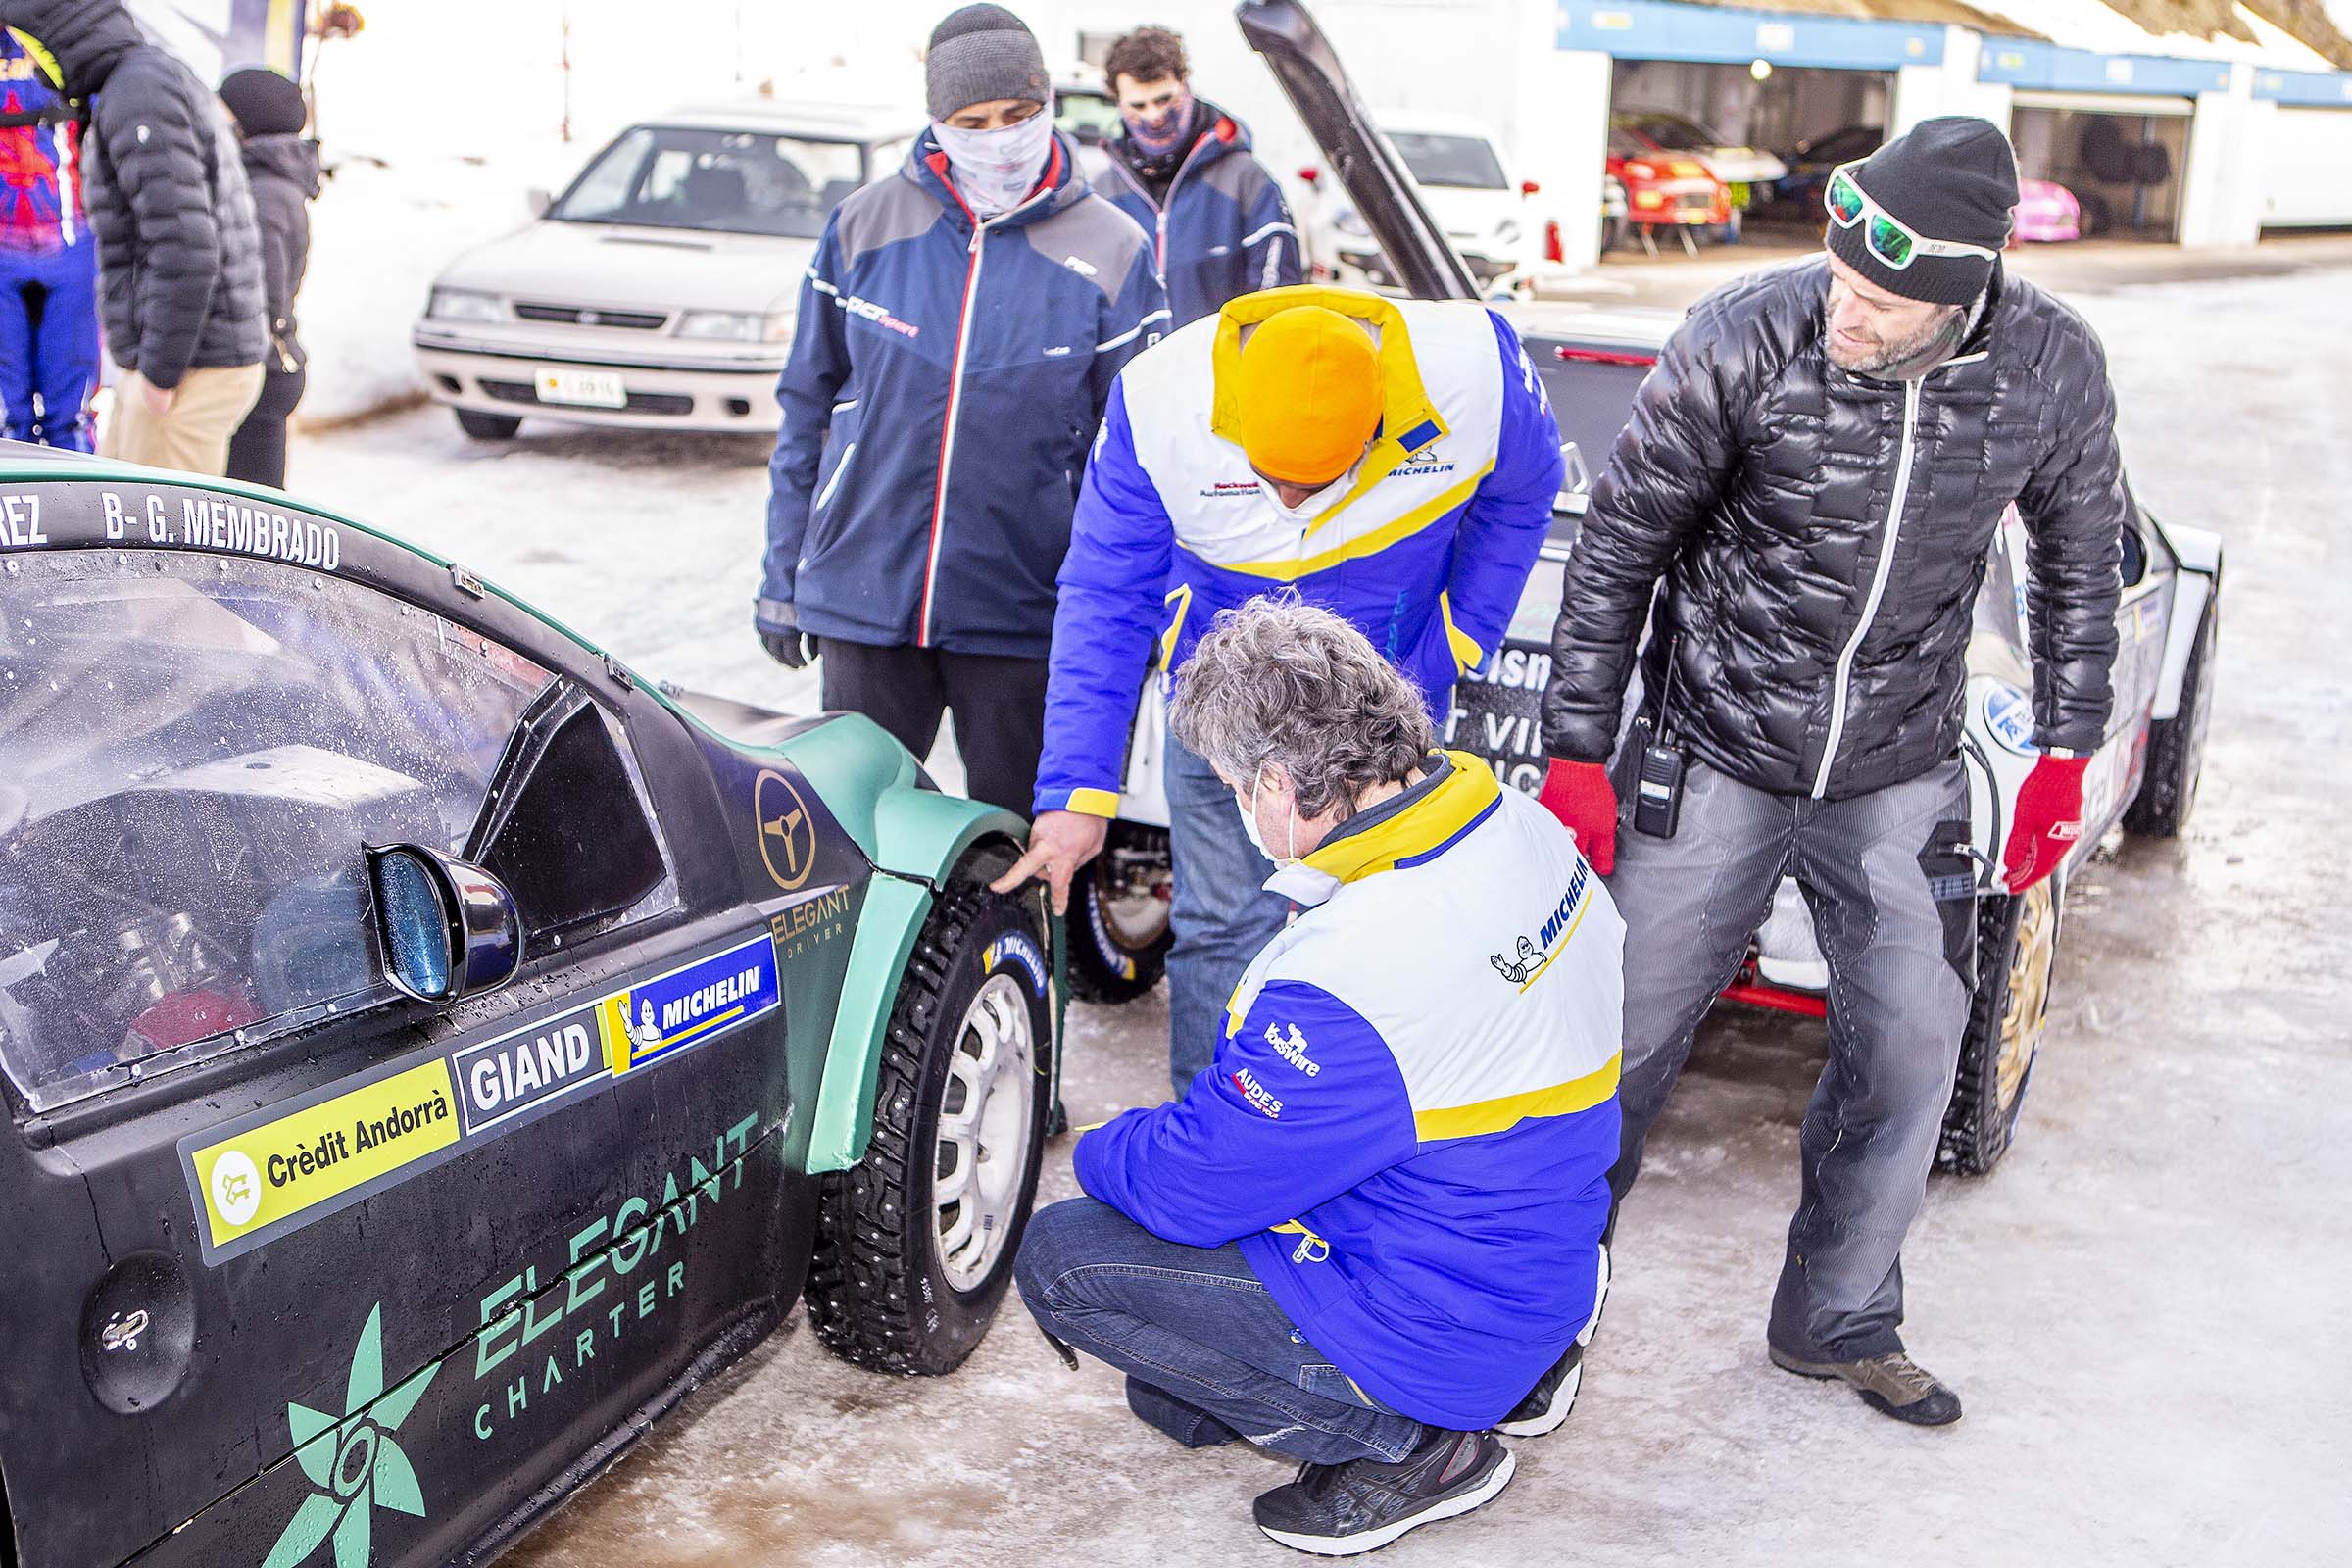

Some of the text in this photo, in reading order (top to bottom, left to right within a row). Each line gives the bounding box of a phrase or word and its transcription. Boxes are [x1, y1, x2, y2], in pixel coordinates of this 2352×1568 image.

[182, 498, 340, 571] MEMBRADO
[771, 884, 849, 945] ELEGANT
[787, 923, 843, 959] DRIVER
[1539, 853, 1589, 951] MICHELIN
[662, 965, 760, 1030] MICHELIN
[470, 1022, 590, 1111] GIAND
[1236, 1068, 1284, 1112] AUDES
[267, 1089, 449, 1188] Crèdit Andorrà
[474, 1111, 759, 1381] ELEGANT
[474, 1260, 685, 1440] CHARTER
